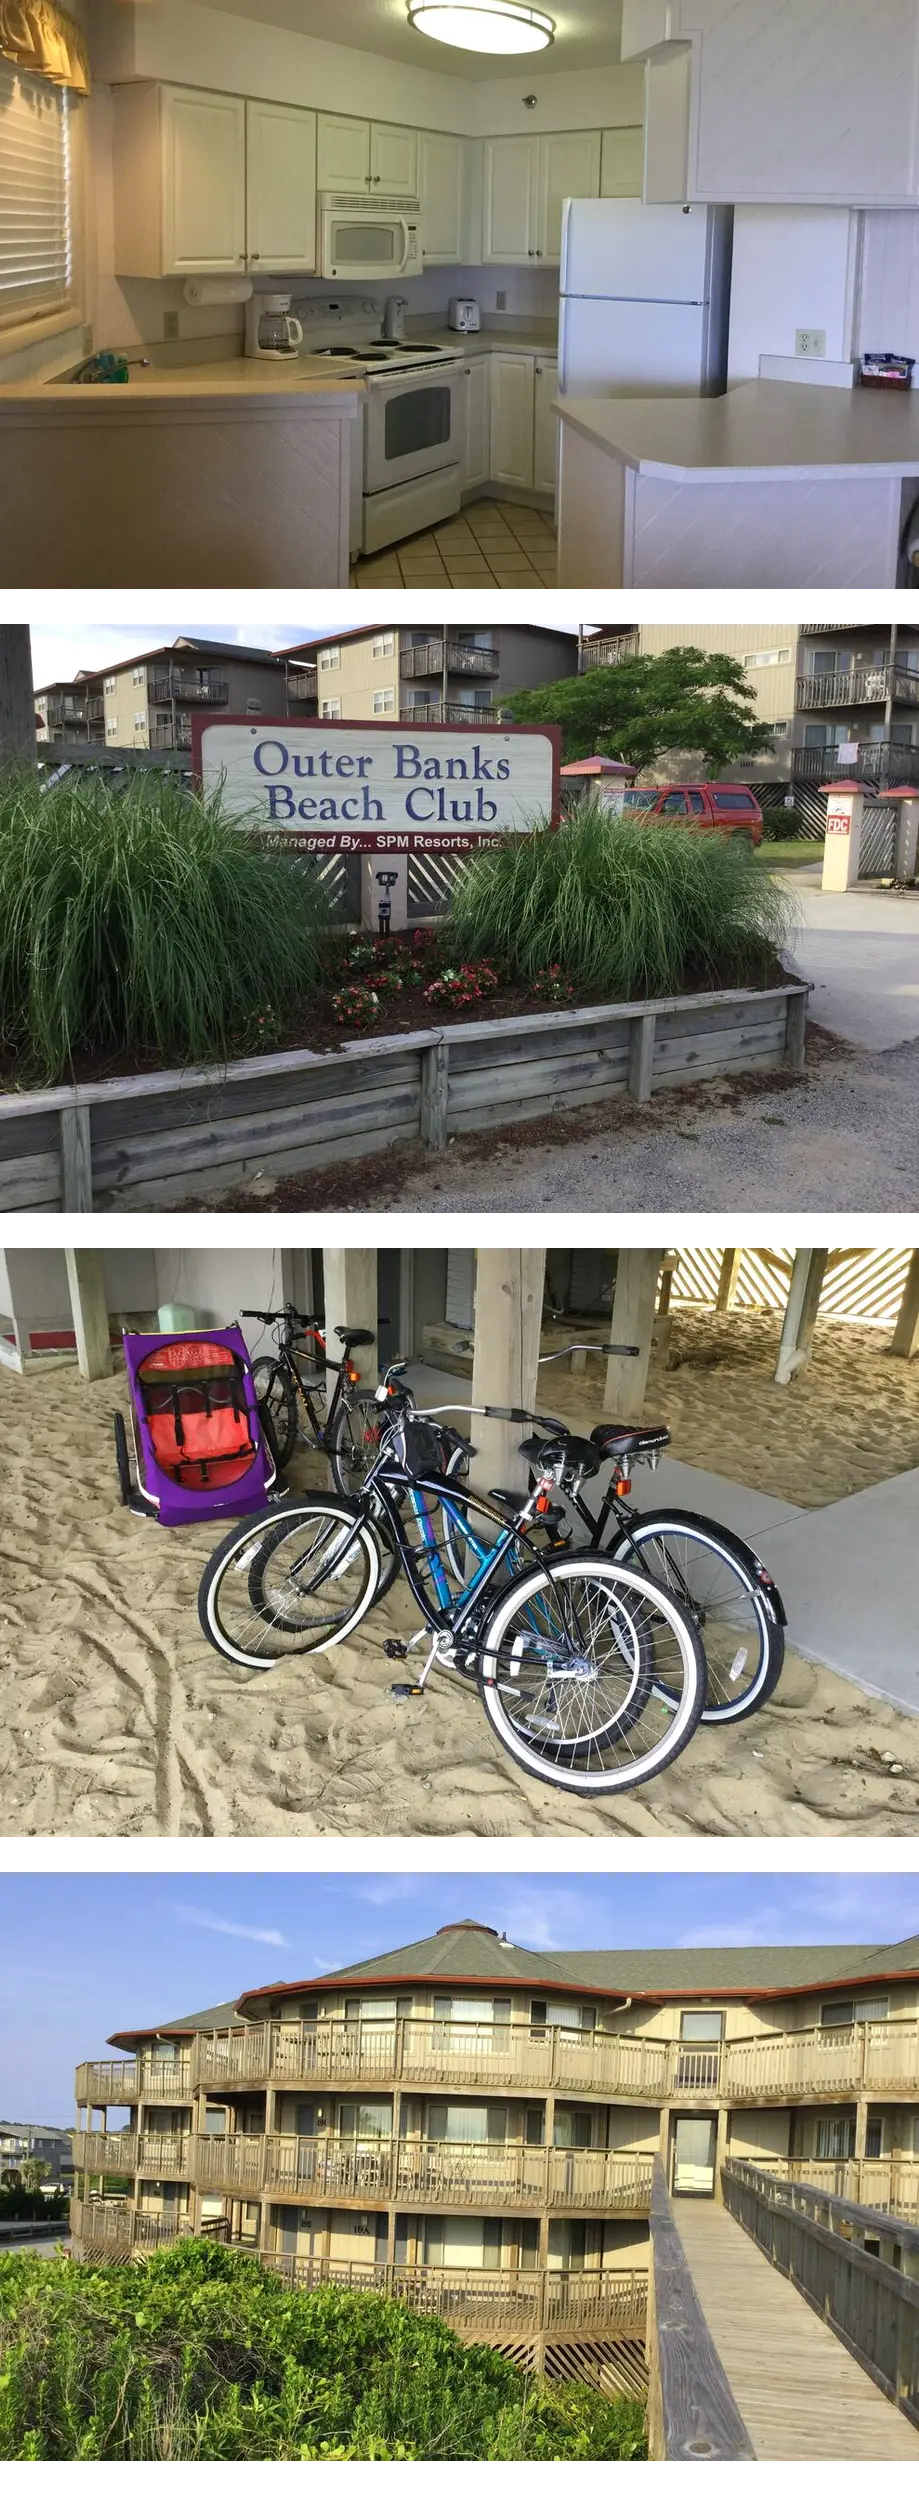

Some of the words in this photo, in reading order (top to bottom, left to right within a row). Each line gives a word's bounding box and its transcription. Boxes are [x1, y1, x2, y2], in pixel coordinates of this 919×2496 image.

[253, 740, 373, 778] Outer
[392, 744, 511, 780] Banks
[263, 784, 388, 821] Beach
[405, 787, 498, 822] Club
[828, 818, 848, 832] FDC
[266, 835, 335, 850] Managed
[340, 836, 372, 850] By...
[376, 835, 409, 848] SPM
[414, 835, 473, 849] Resorts,
[478, 836, 502, 848] Inc.
[354, 2225, 370, 2235] 19A
